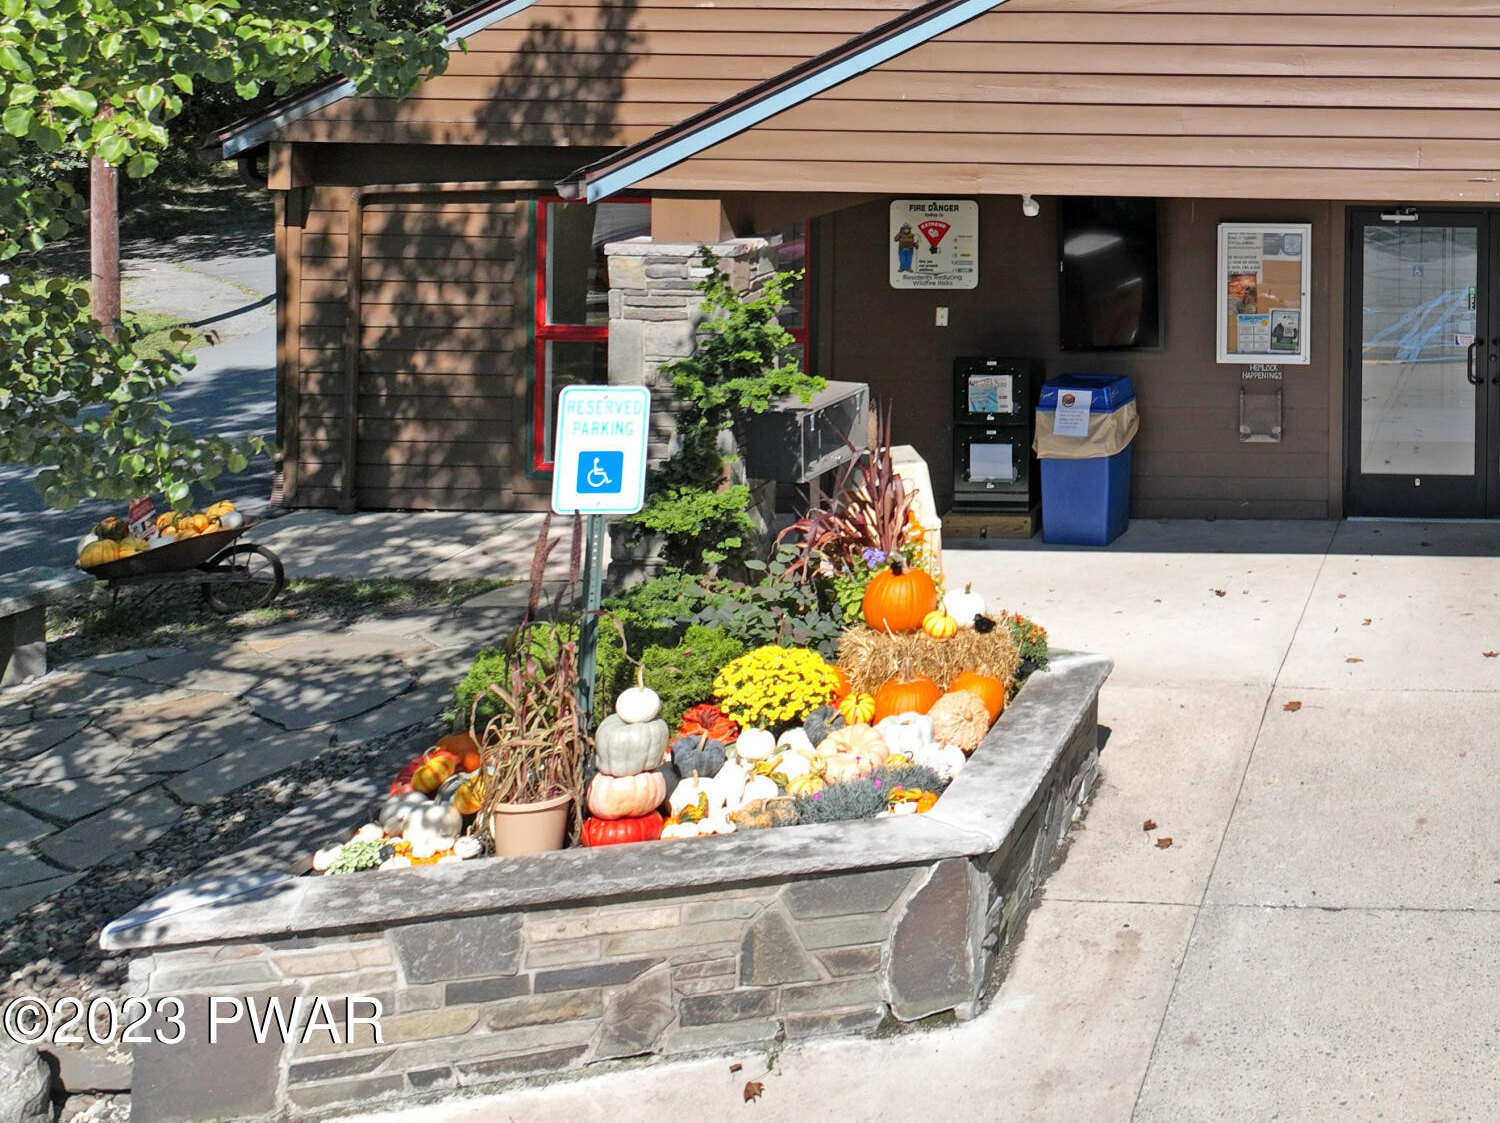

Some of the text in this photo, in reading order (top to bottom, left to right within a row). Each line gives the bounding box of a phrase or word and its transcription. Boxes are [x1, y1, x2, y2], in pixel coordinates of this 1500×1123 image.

[909, 204, 959, 212] FIRE DANGER
[1249, 364, 1278, 372] HEMLOCK
[1242, 372, 1283, 380] HAPPENINGS
[567, 399, 642, 415] RESERVED
[572, 421, 634, 436] PARKING
